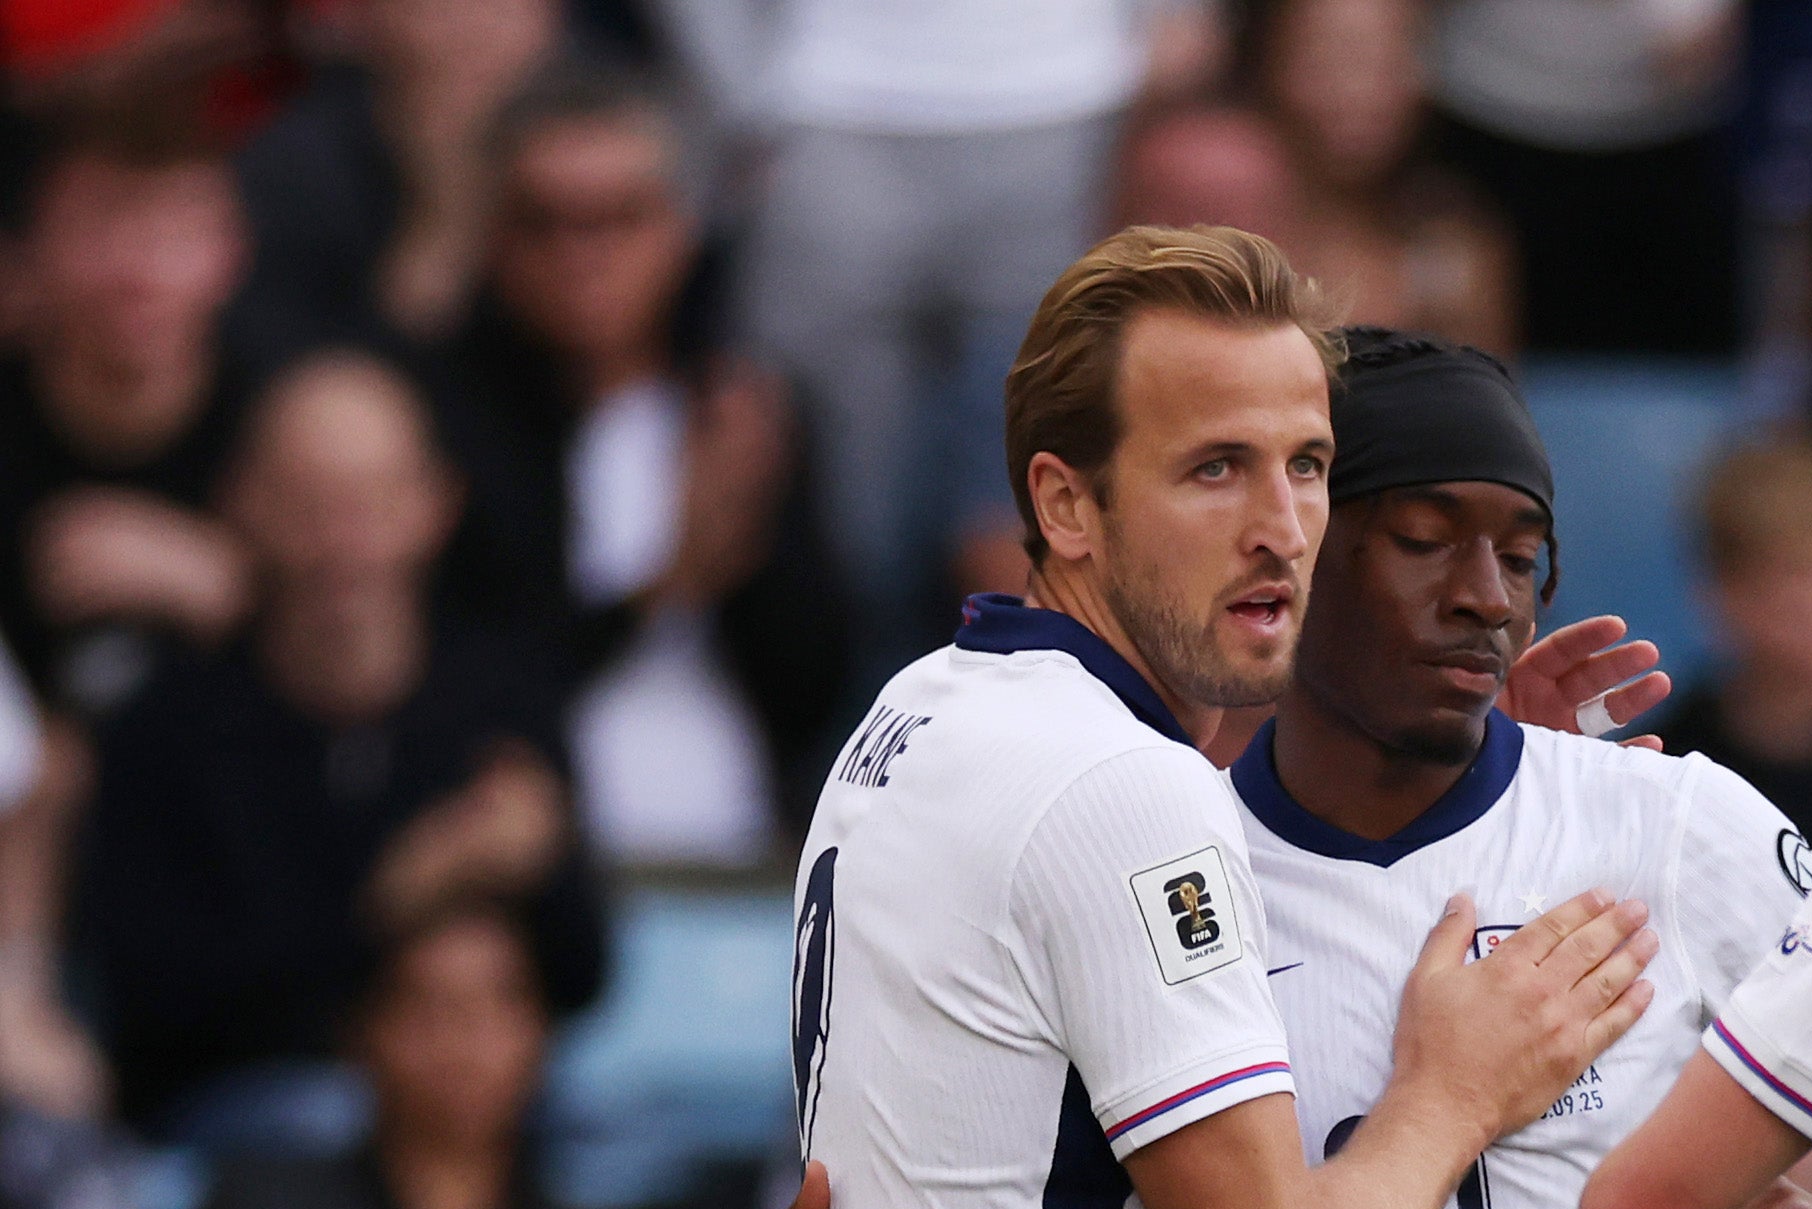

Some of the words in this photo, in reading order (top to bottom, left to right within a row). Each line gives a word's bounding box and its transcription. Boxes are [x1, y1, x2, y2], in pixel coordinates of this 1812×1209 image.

[837, 705, 933, 788] KANE
[1190, 929, 1212, 944] FIFA
[1540, 1090, 1604, 1120] .09.25
